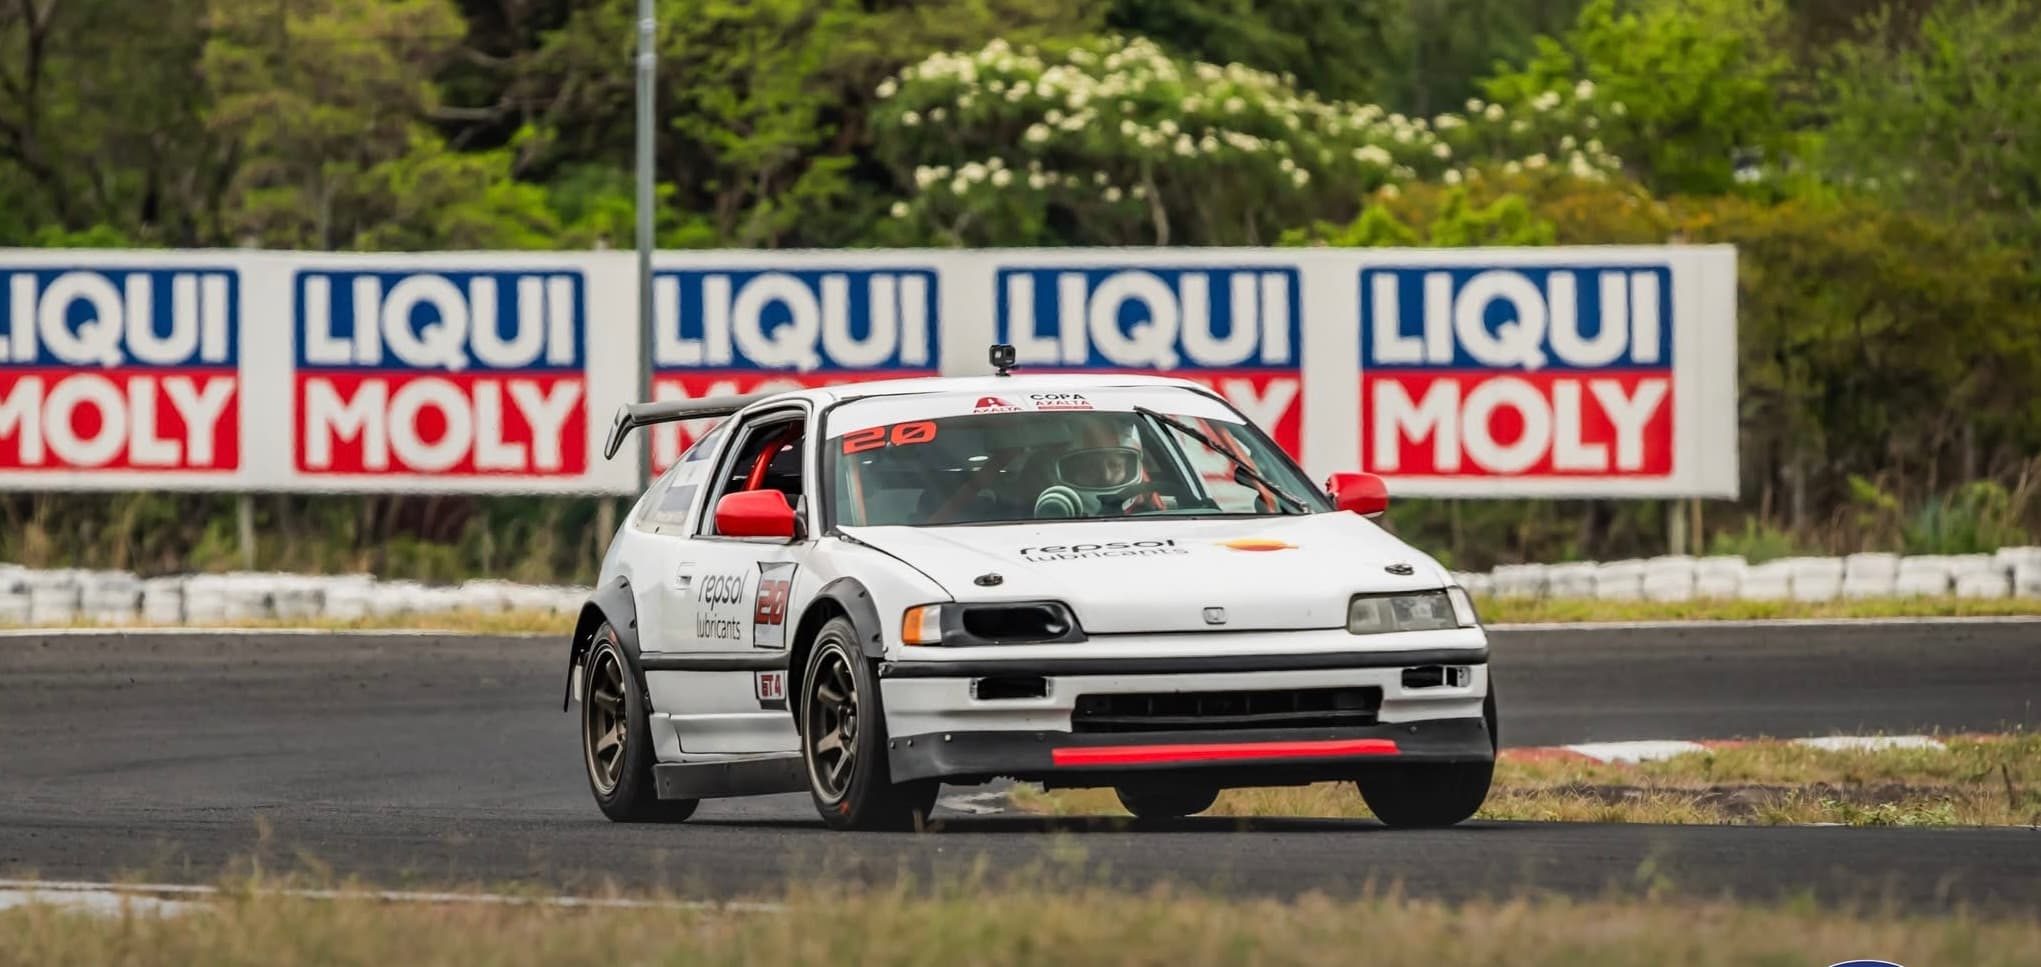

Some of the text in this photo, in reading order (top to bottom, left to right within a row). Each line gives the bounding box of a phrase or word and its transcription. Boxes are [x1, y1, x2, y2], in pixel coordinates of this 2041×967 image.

[0, 271, 230, 368] IQUI
[303, 273, 576, 371] LIQUI
[651, 271, 931, 371] LIQUI
[1008, 270, 1291, 370] LIQUI
[1371, 269, 1661, 371] LIQUI
[303, 377, 583, 471] MOLY
[842, 420, 938, 456] 20
[1371, 376, 1669, 473] MOLY
[697, 569, 749, 611] repsol
[1020, 539, 1175, 555] repsol
[1026, 549, 1189, 562] lubricants
[696, 611, 741, 640] lubricants
[754, 580, 789, 625] 20
